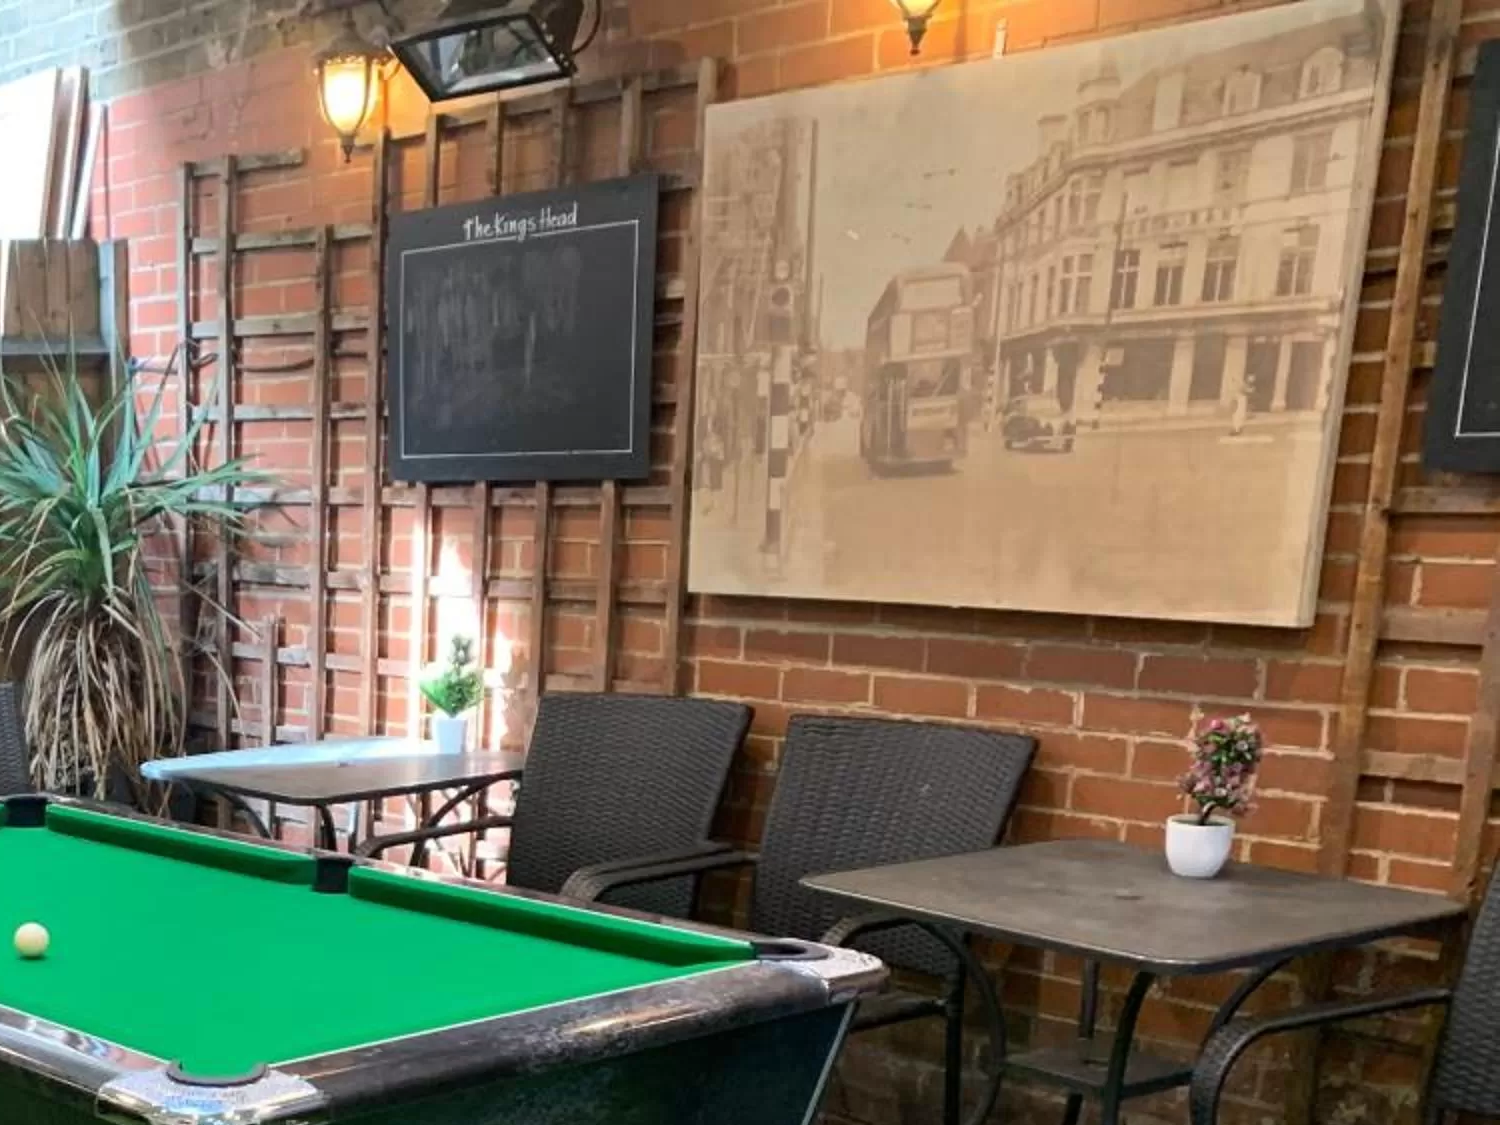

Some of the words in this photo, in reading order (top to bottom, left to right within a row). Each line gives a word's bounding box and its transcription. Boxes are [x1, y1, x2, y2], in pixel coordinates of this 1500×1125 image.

[463, 214, 493, 240] The
[494, 211, 537, 242] Kings
[540, 200, 578, 229] Head
